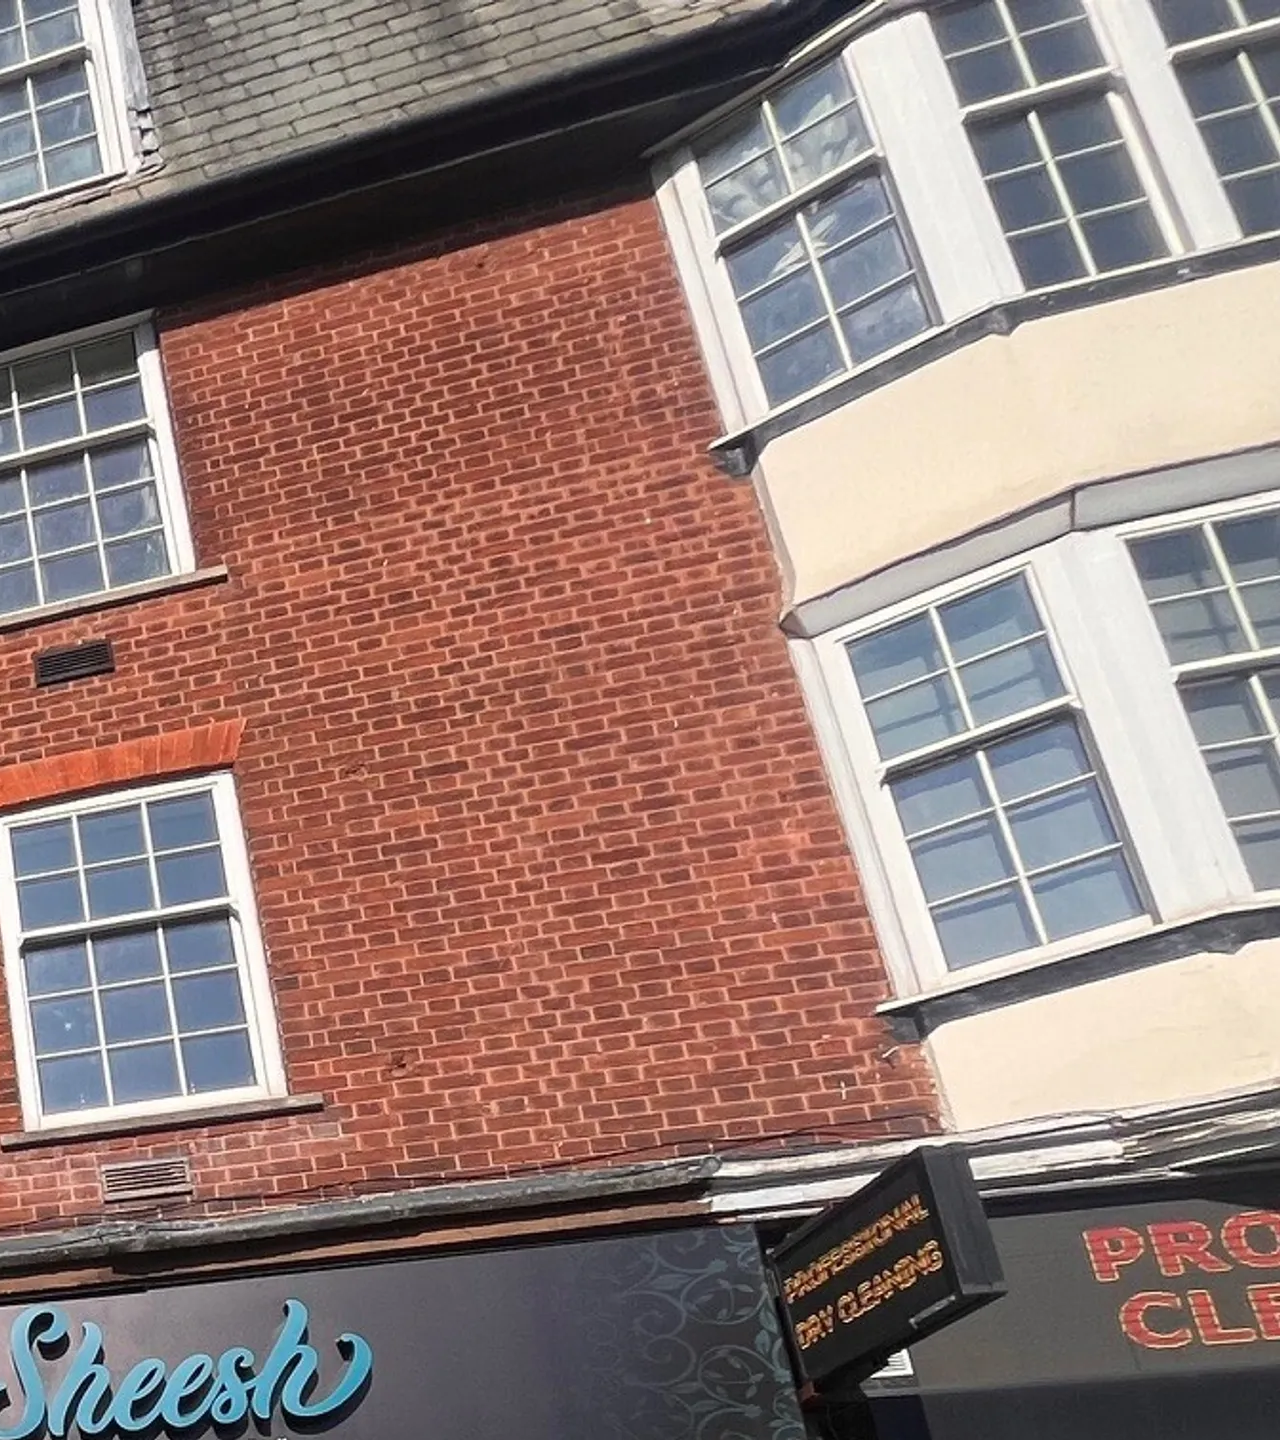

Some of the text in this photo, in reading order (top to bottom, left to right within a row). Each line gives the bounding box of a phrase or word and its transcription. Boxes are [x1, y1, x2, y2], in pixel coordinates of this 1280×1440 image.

[1082, 1210, 1280, 1283] PRO
[795, 1240, 944, 1350] DRY CLEANING
[1118, 1282, 1280, 1350] CLE
